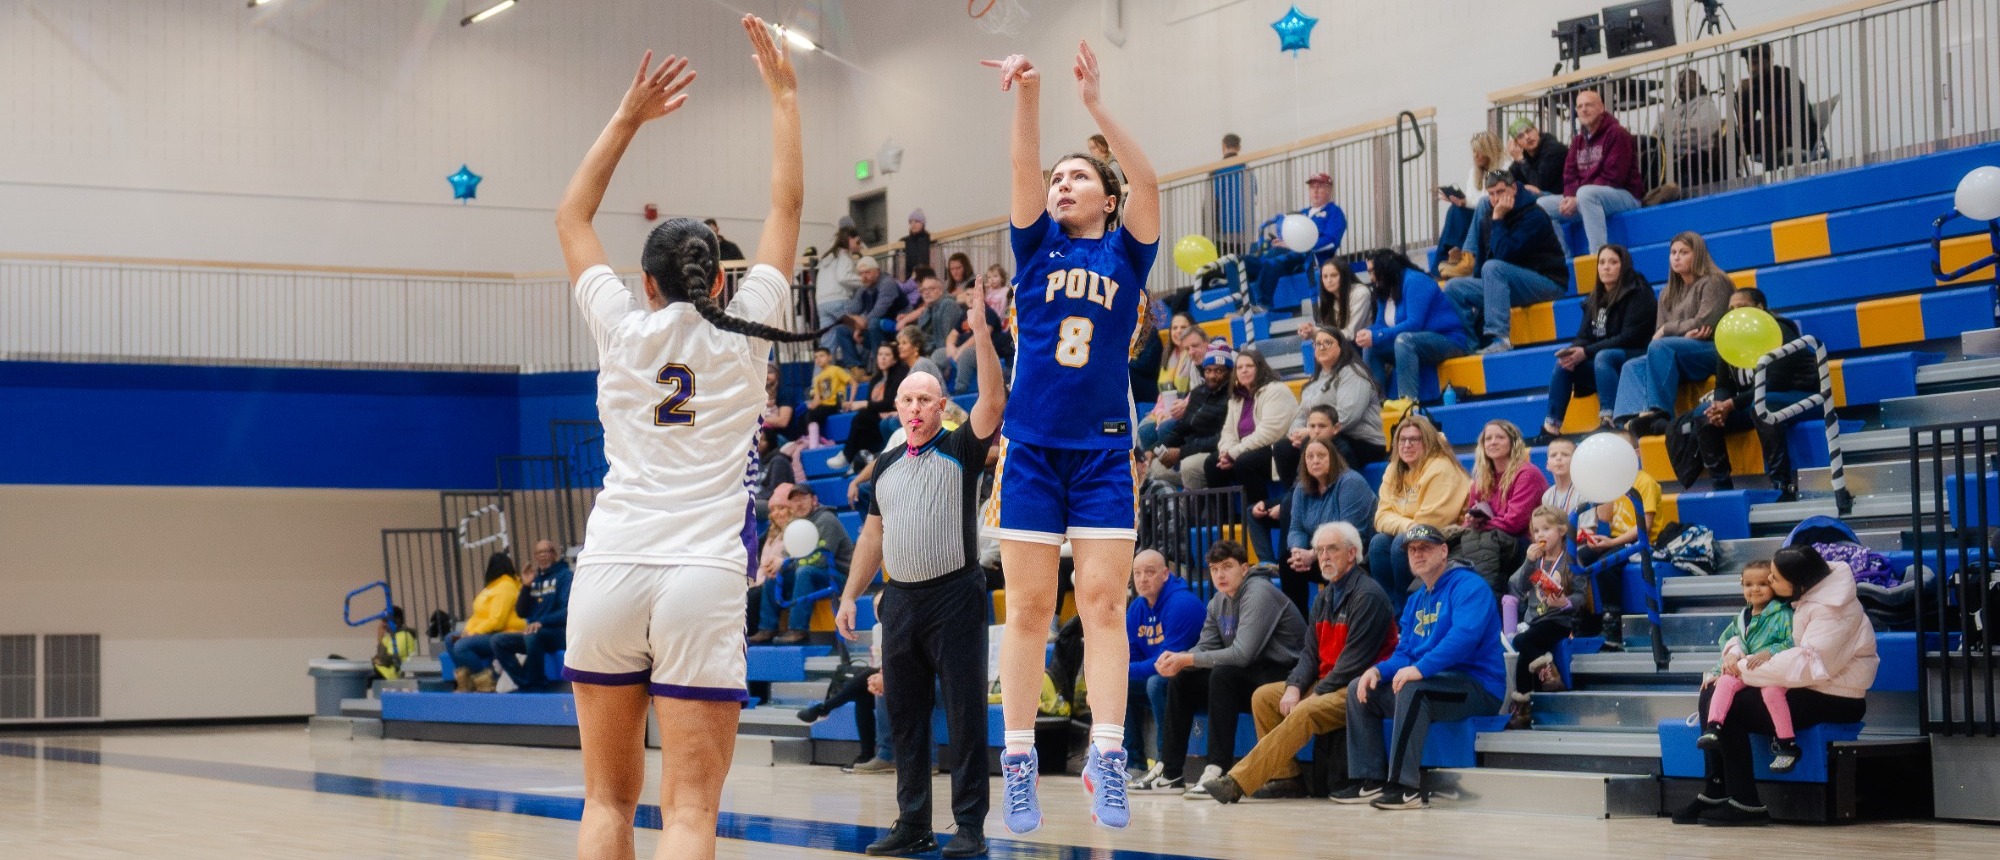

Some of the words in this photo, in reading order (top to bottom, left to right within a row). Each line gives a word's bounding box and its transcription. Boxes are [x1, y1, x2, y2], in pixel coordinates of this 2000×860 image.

[1045, 267, 1119, 311] POLY
[1055, 315, 1094, 368] 8
[654, 363, 695, 426] 2
